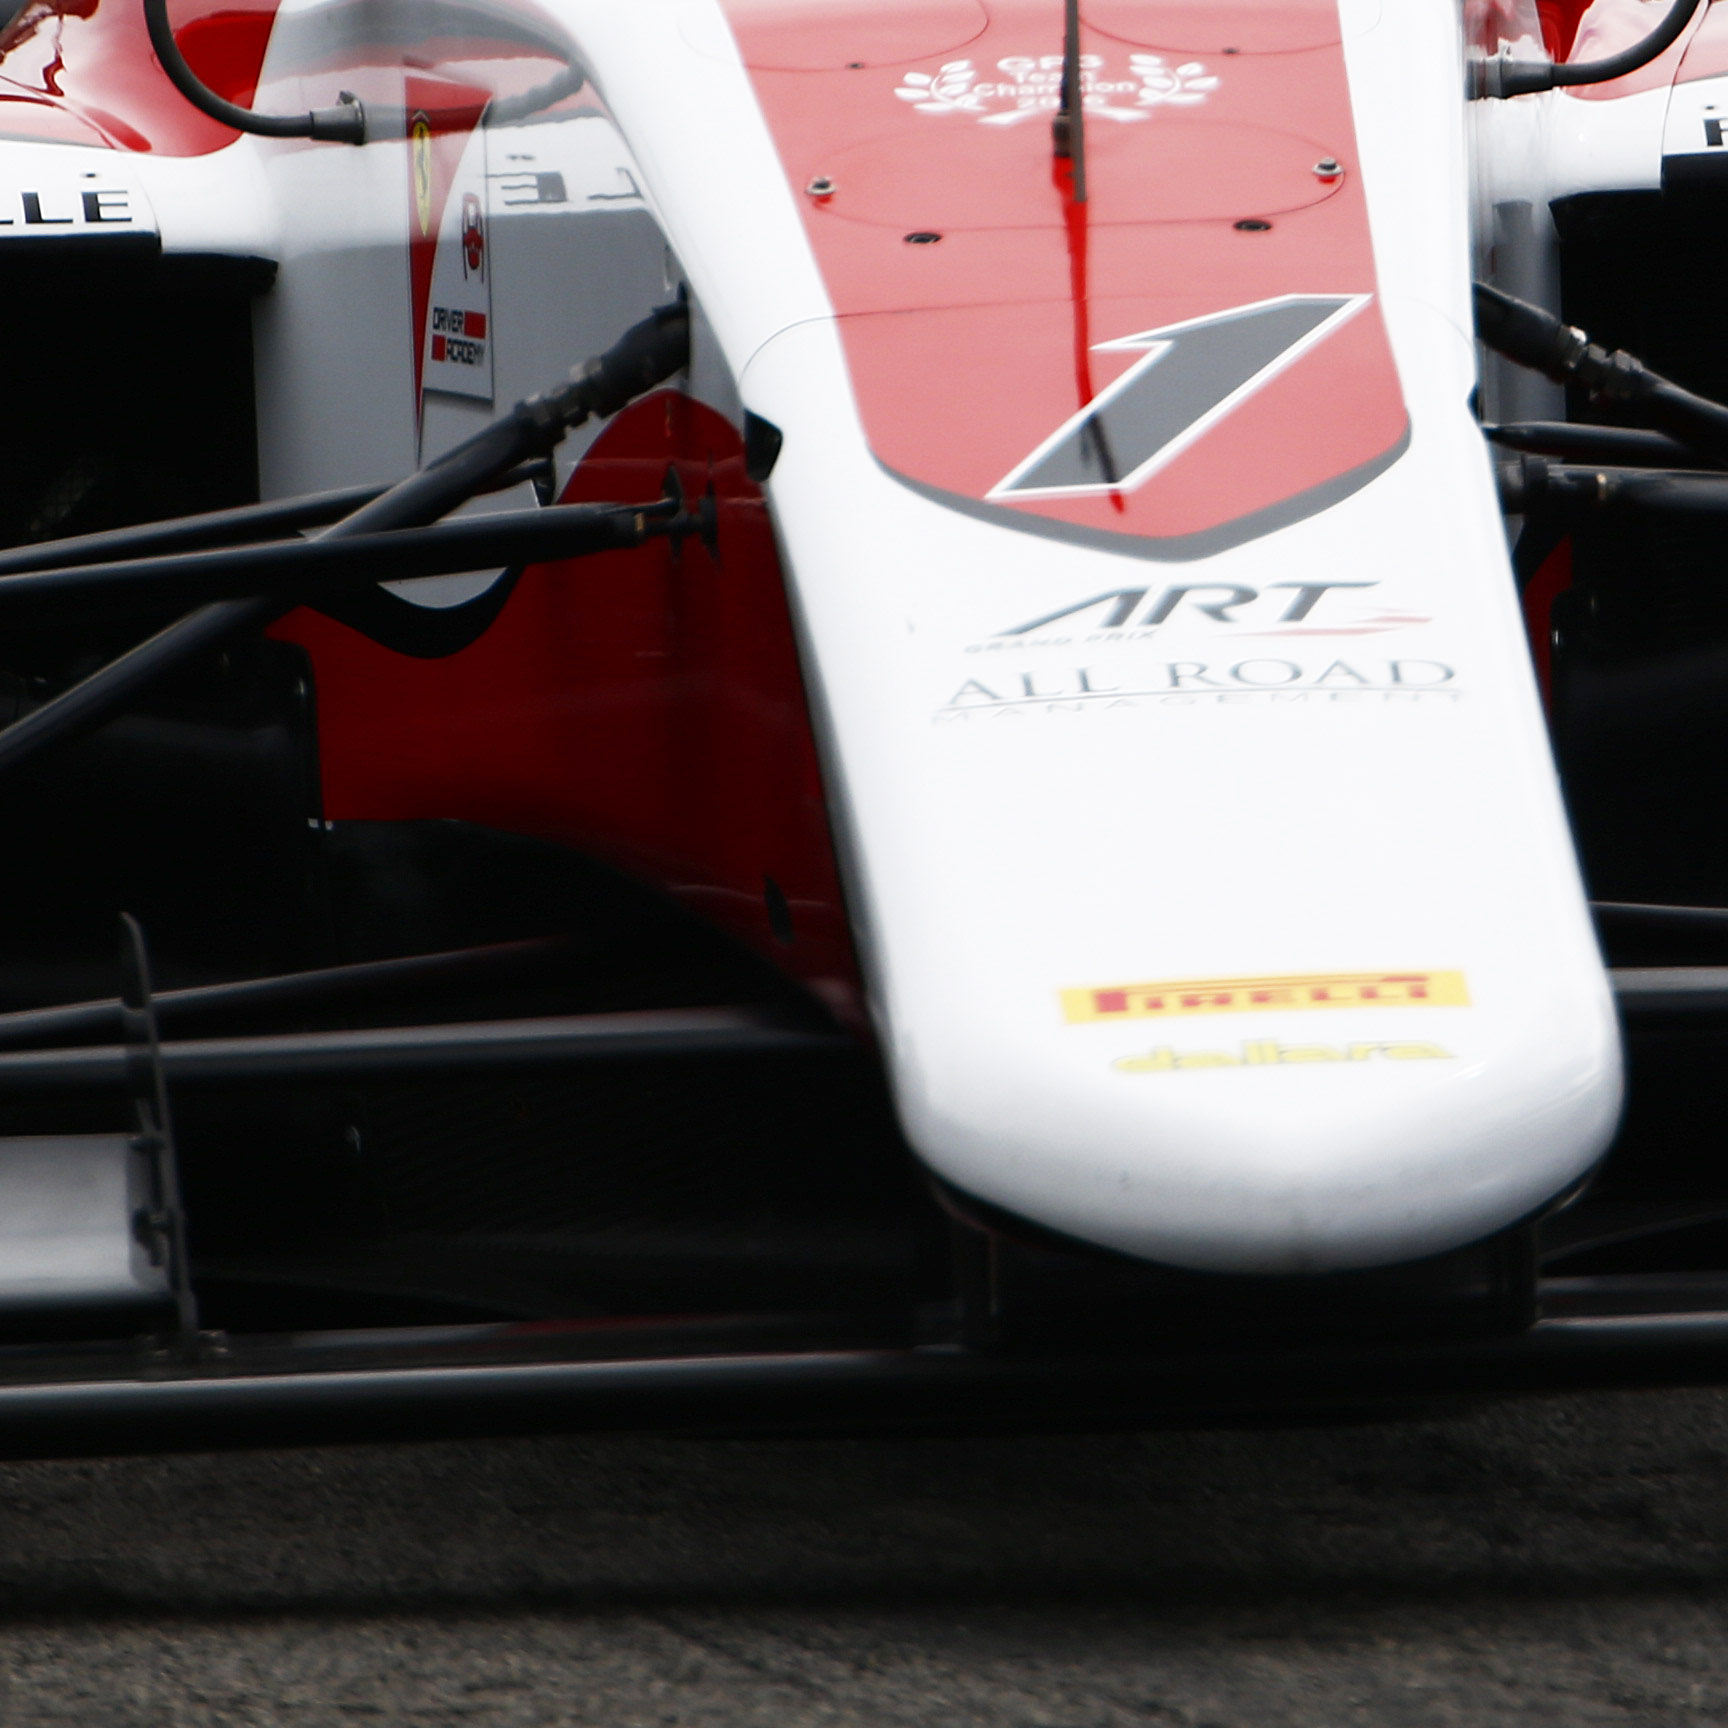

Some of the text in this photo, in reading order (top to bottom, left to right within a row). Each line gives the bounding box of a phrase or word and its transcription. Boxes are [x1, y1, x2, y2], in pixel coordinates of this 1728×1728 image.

[432, 306, 464, 332] DRIVER
[447, 337, 486, 366] ACADEMY
[984, 293, 1373, 502] 1
[989, 580, 1380, 638] ART
[947, 657, 1457, 707] ALL ROAD
